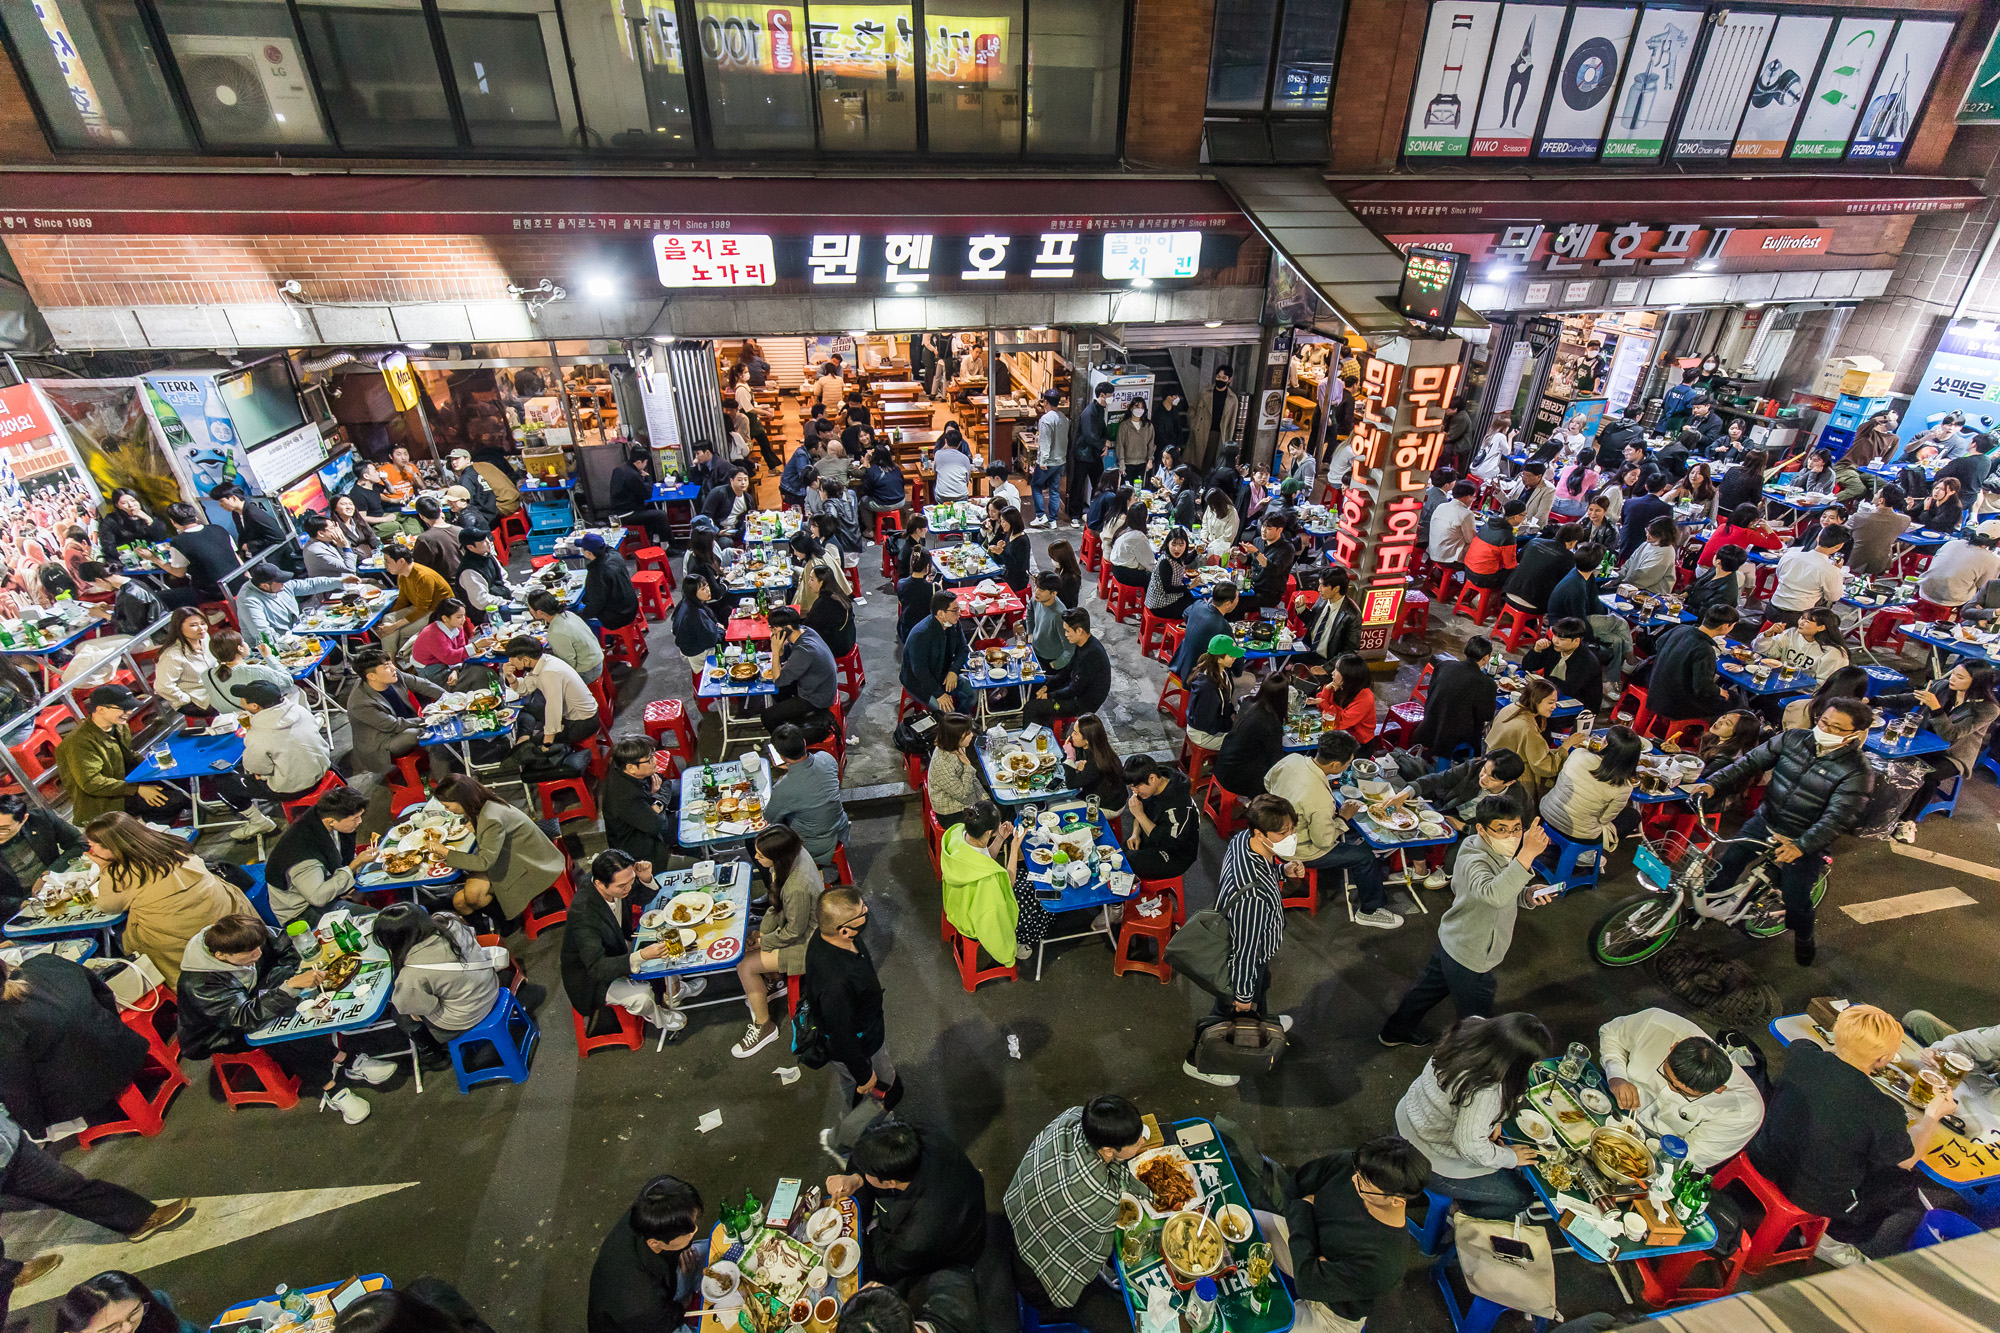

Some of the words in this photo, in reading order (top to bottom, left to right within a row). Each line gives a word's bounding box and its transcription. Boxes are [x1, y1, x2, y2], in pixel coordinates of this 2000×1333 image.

[272, 67, 287, 77] LG
[1408, 140, 1446, 152] SONANE
[1448, 143, 1463, 151] Cart
[1473, 141, 1499, 152] NIKO
[1503, 144, 1527, 152] Scissors
[1541, 142, 1569, 153] PFERD
[1604, 142, 1637, 154] SONANE
[1635, 146, 1649, 155] Spray
[1676, 142, 1699, 155] TOHO
[1698, 145, 1713, 155] Chain
[1733, 143, 1761, 156] SANOU
[1793, 143, 1824, 155] SONANE
[1823, 145, 1843, 155] Ladder
[1850, 143, 1875, 156] PFERD
[1361, 205, 1403, 215] 을지로노가리
[1407, 204, 1448, 215] 을지로골뱅이
[1450, 206, 1467, 215] Since
[1468, 205, 1483, 214] 1989
[0, 217, 27, 229] 뱅이
[34, 218, 63, 229] Since
[66, 218, 93, 228] 1989
[513, 218, 553, 230] 뮌헨호프
[557, 218, 617, 230] 을지로노가리
[623, 219, 681, 231] 을지로골뱅이
[686, 220, 707, 230] Since
[711, 220, 731, 229] 1989
[1050, 220, 1082, 230] 뮌헨호프
[1086, 219, 1135, 230] 을지로노가리
[1138, 218, 1185, 230] 을지로골뱅이
[1188, 219, 1207, 228] Since
[1210, 218, 1226, 228] 1989
[664, 237, 741, 261] 을지로
[1110, 233, 1175, 255] 골뱅이
[1761, 234, 1822, 252] Euljirofest
[691, 263, 766, 284] 노가리
[396, 371, 411, 387] Max
[157, 381, 200, 393] TERRA
[1372, 364, 1461, 586] 뮌헨호프
[1361, 629, 1385, 638] INCE
[1360, 638, 1383, 650] 989
[711, 936, 736, 959] 93
